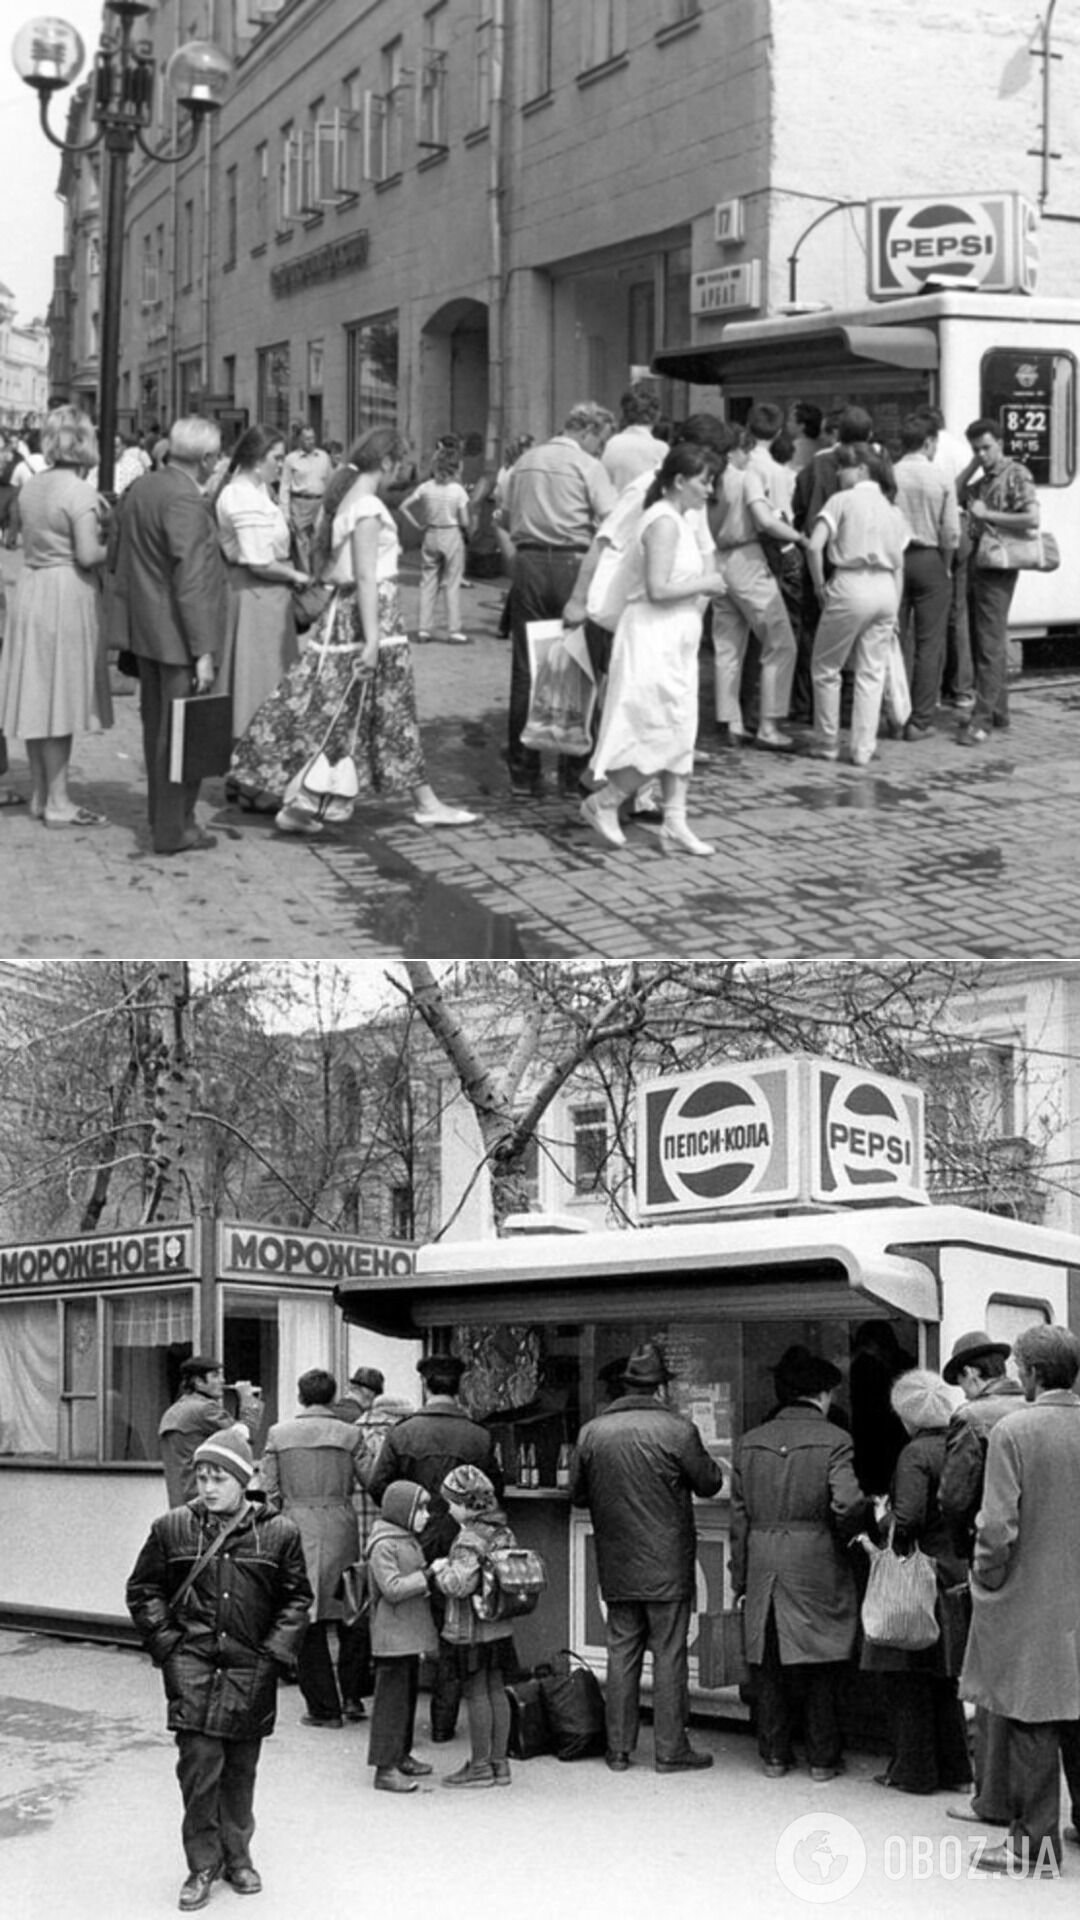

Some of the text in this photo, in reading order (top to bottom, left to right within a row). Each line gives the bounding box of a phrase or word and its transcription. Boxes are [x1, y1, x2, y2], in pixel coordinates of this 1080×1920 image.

[890, 234, 993, 258] PEPSI
[829, 1122, 911, 1165] PEPSI
[1, 1237, 160, 1284] МОРОЖЕНОЕ
[231, 1232, 417, 1277] МОРОЖЕНО
